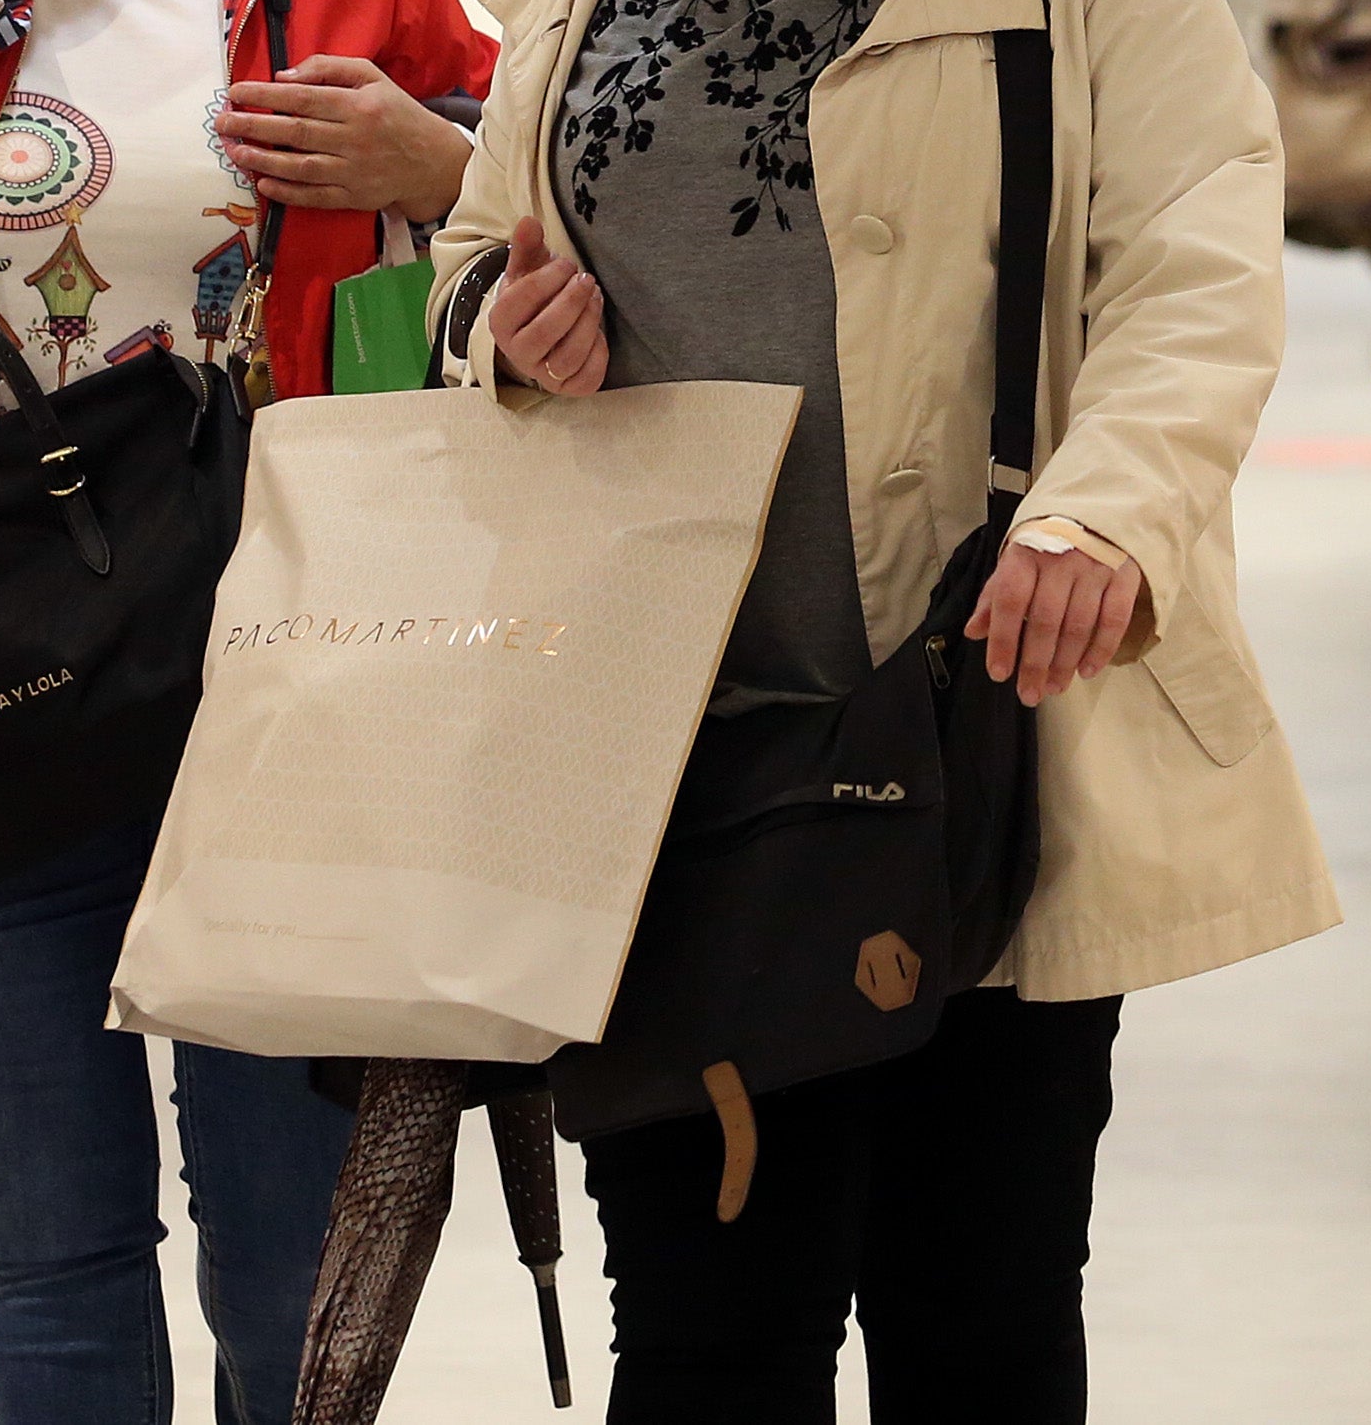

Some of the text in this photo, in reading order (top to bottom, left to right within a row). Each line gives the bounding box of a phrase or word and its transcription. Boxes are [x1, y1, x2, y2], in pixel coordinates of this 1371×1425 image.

[348, 293, 366, 364] benetton.com
[10, 685, 23, 702] Y
[27, 668, 74, 696] LOLA
[833, 782, 906, 801] FILA
